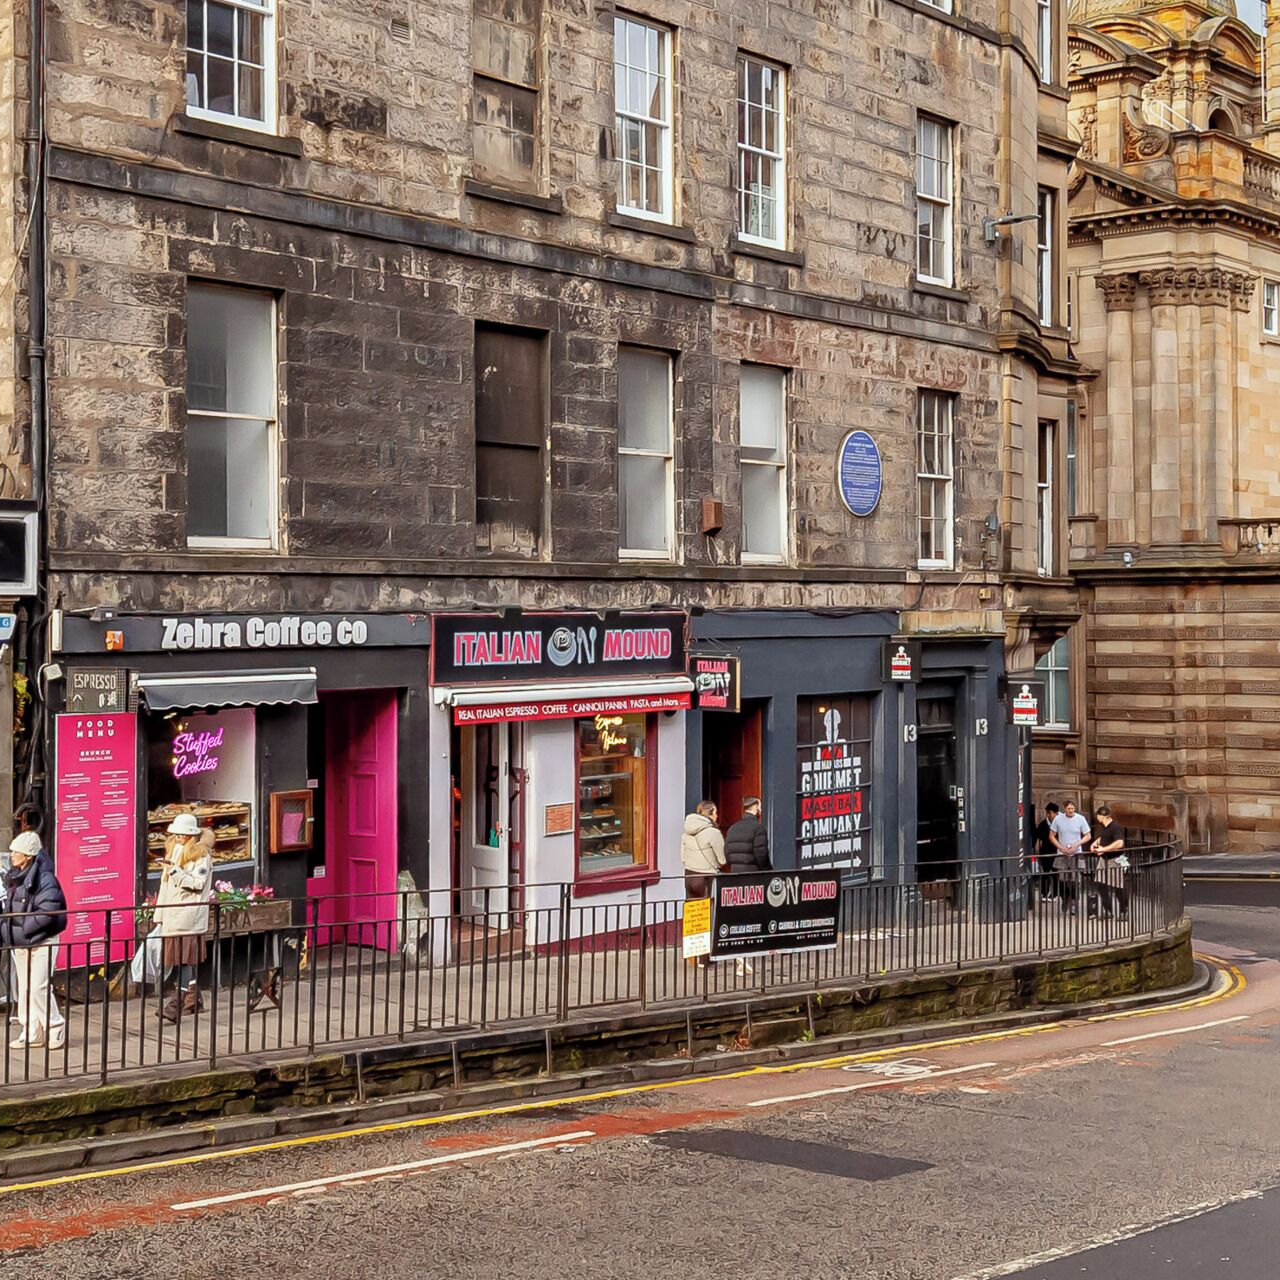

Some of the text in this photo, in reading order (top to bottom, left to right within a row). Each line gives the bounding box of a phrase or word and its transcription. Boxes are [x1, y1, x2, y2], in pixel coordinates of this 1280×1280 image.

[161, 618, 241, 649] Zebra
[246, 616, 332, 647] Coffee
[453, 631, 542, 666] ITALIAN
[602, 628, 672, 661] MOUND
[74, 673, 116, 690] ESPRESSO
[458, 710, 476, 720] REAL
[476, 707, 505, 719] ITALIAN
[505, 705, 539, 717] ESPRESSO
[542, 704, 568, 715] COFFEE
[630, 698, 650, 708] PASTA
[650, 697, 663, 707] and
[76, 729, 114, 738] MENU
[77, 721, 114, 729] FOOD
[903, 724, 918, 743] 13
[975, 718, 989, 736] 13
[173, 727, 223, 756] Stuffed
[174, 754, 218, 778] Cookies
[801, 768, 862, 792] GOURMET
[801, 813, 862, 839] COMPANY
[721, 885, 764, 907] ITALIAN
[801, 880, 837, 901] MOUND
